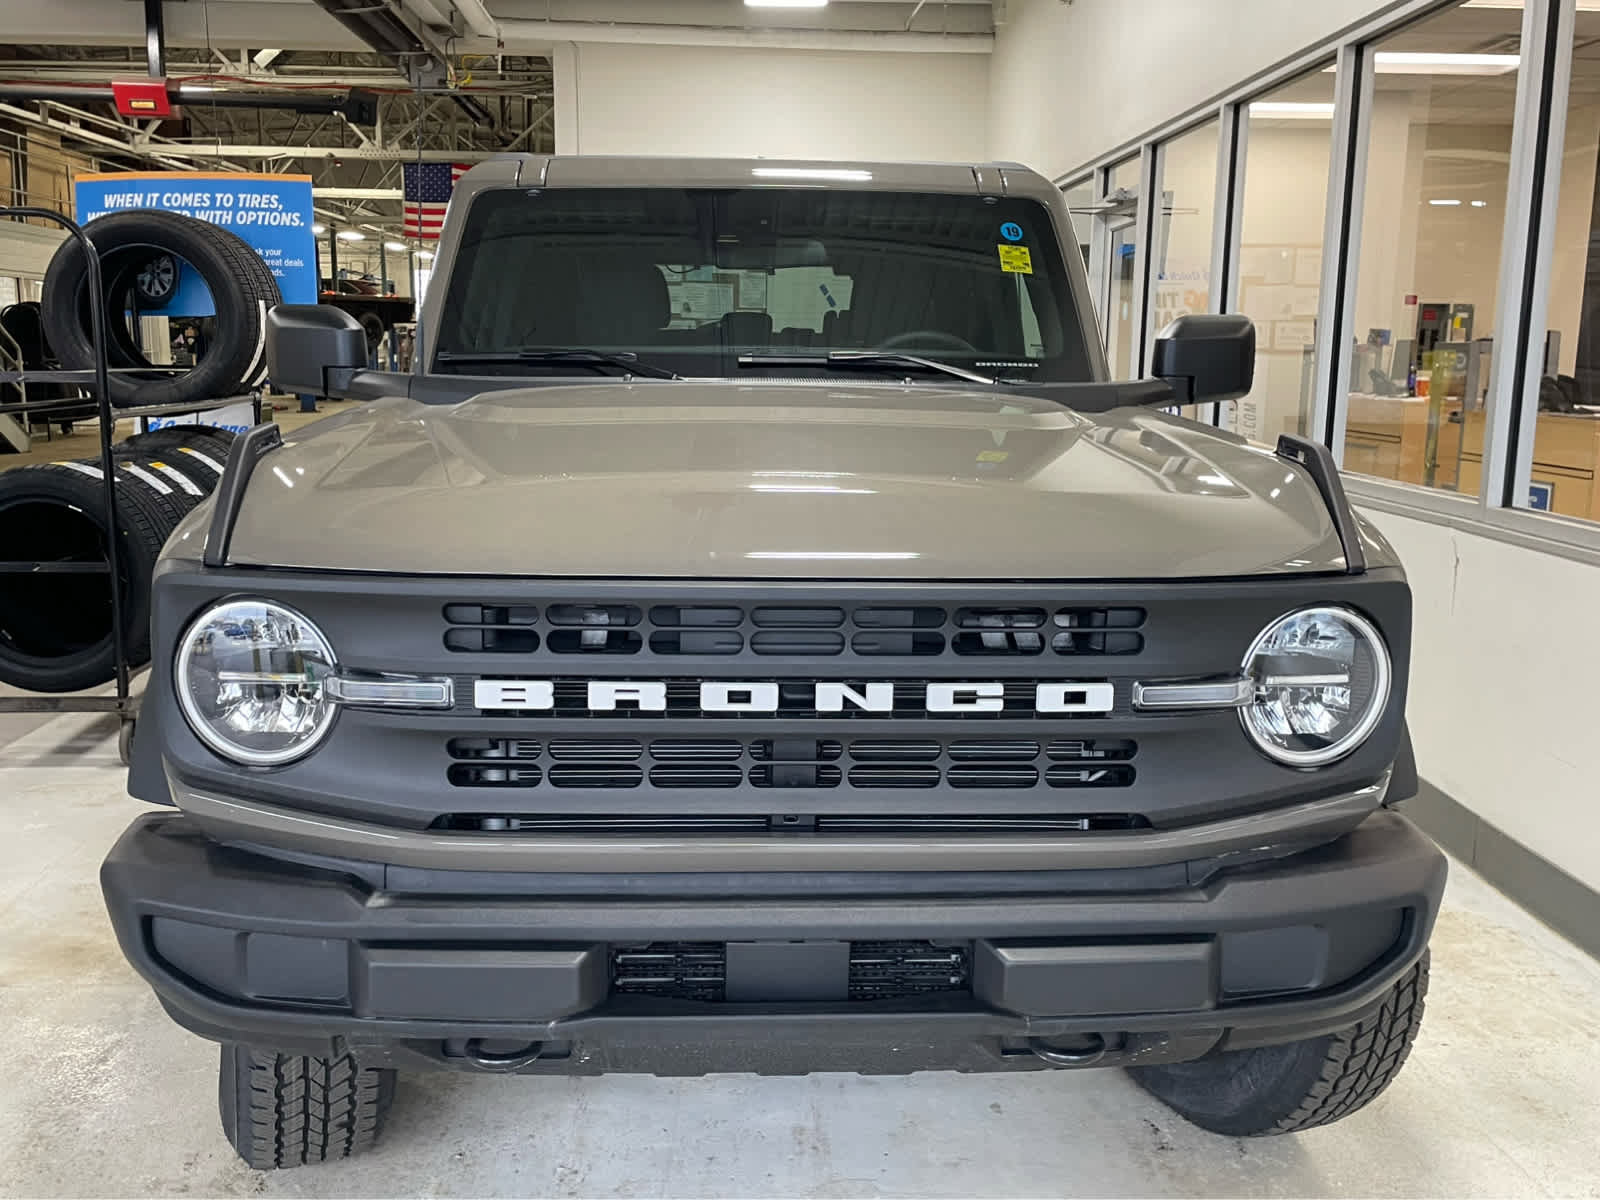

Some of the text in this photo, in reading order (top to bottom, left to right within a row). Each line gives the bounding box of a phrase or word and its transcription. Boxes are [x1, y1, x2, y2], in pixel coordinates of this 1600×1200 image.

[104, 193, 284, 211] WHEN IT COMES TO TIRES,
[194, 210, 235, 225] WITH
[236, 212, 305, 227] OPTIONS.
[1005, 226, 1020, 237] 19
[265, 248, 282, 257] your
[474, 678, 1115, 714] BRONCO
